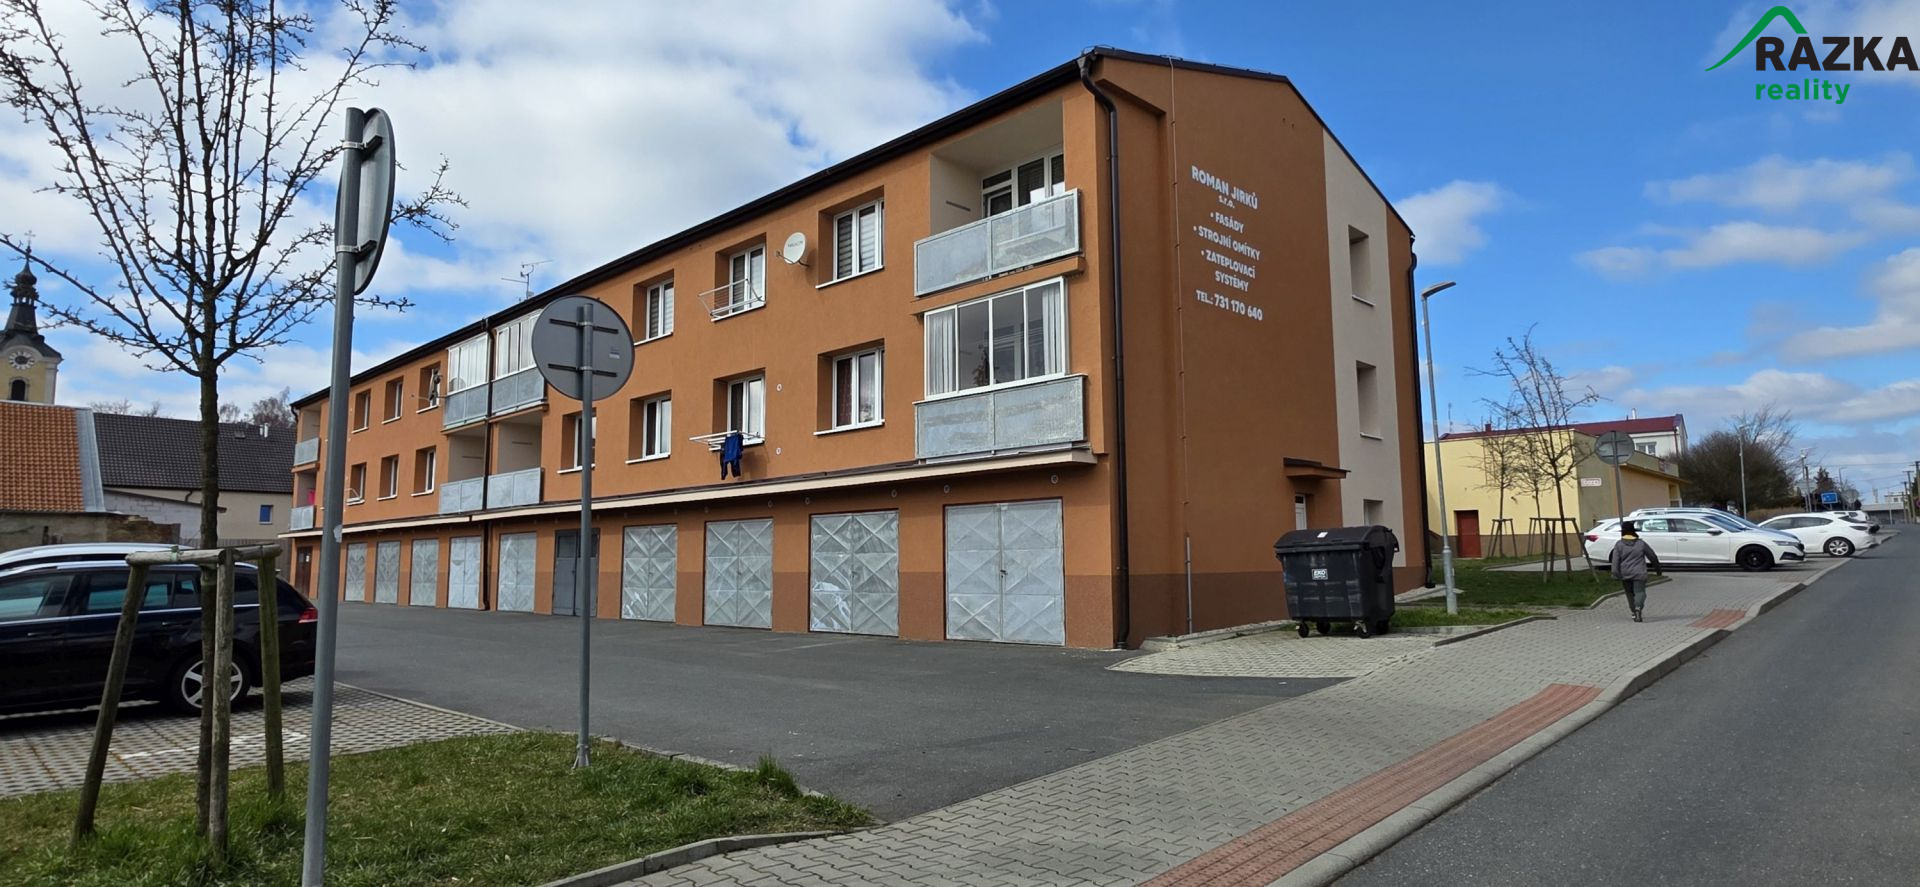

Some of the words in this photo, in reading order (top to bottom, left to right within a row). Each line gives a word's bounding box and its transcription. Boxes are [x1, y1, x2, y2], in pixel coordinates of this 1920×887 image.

[1191, 165, 1229, 196] ROMAN
[1231, 187, 1258, 209] JIRKŮ
[1215, 212, 1244, 233] FASÁDY
[1198, 225, 1232, 249] STROJNÍ
[1233, 239, 1260, 261] OMÍTKY
[1206, 250, 1256, 279] ZATEPLOVACÍ
[1215, 270, 1249, 292] SYSTÉMY
[1214, 294, 1229, 310] 731
[1230, 300, 1246, 316] 170
[1248, 306, 1263, 321] 640
